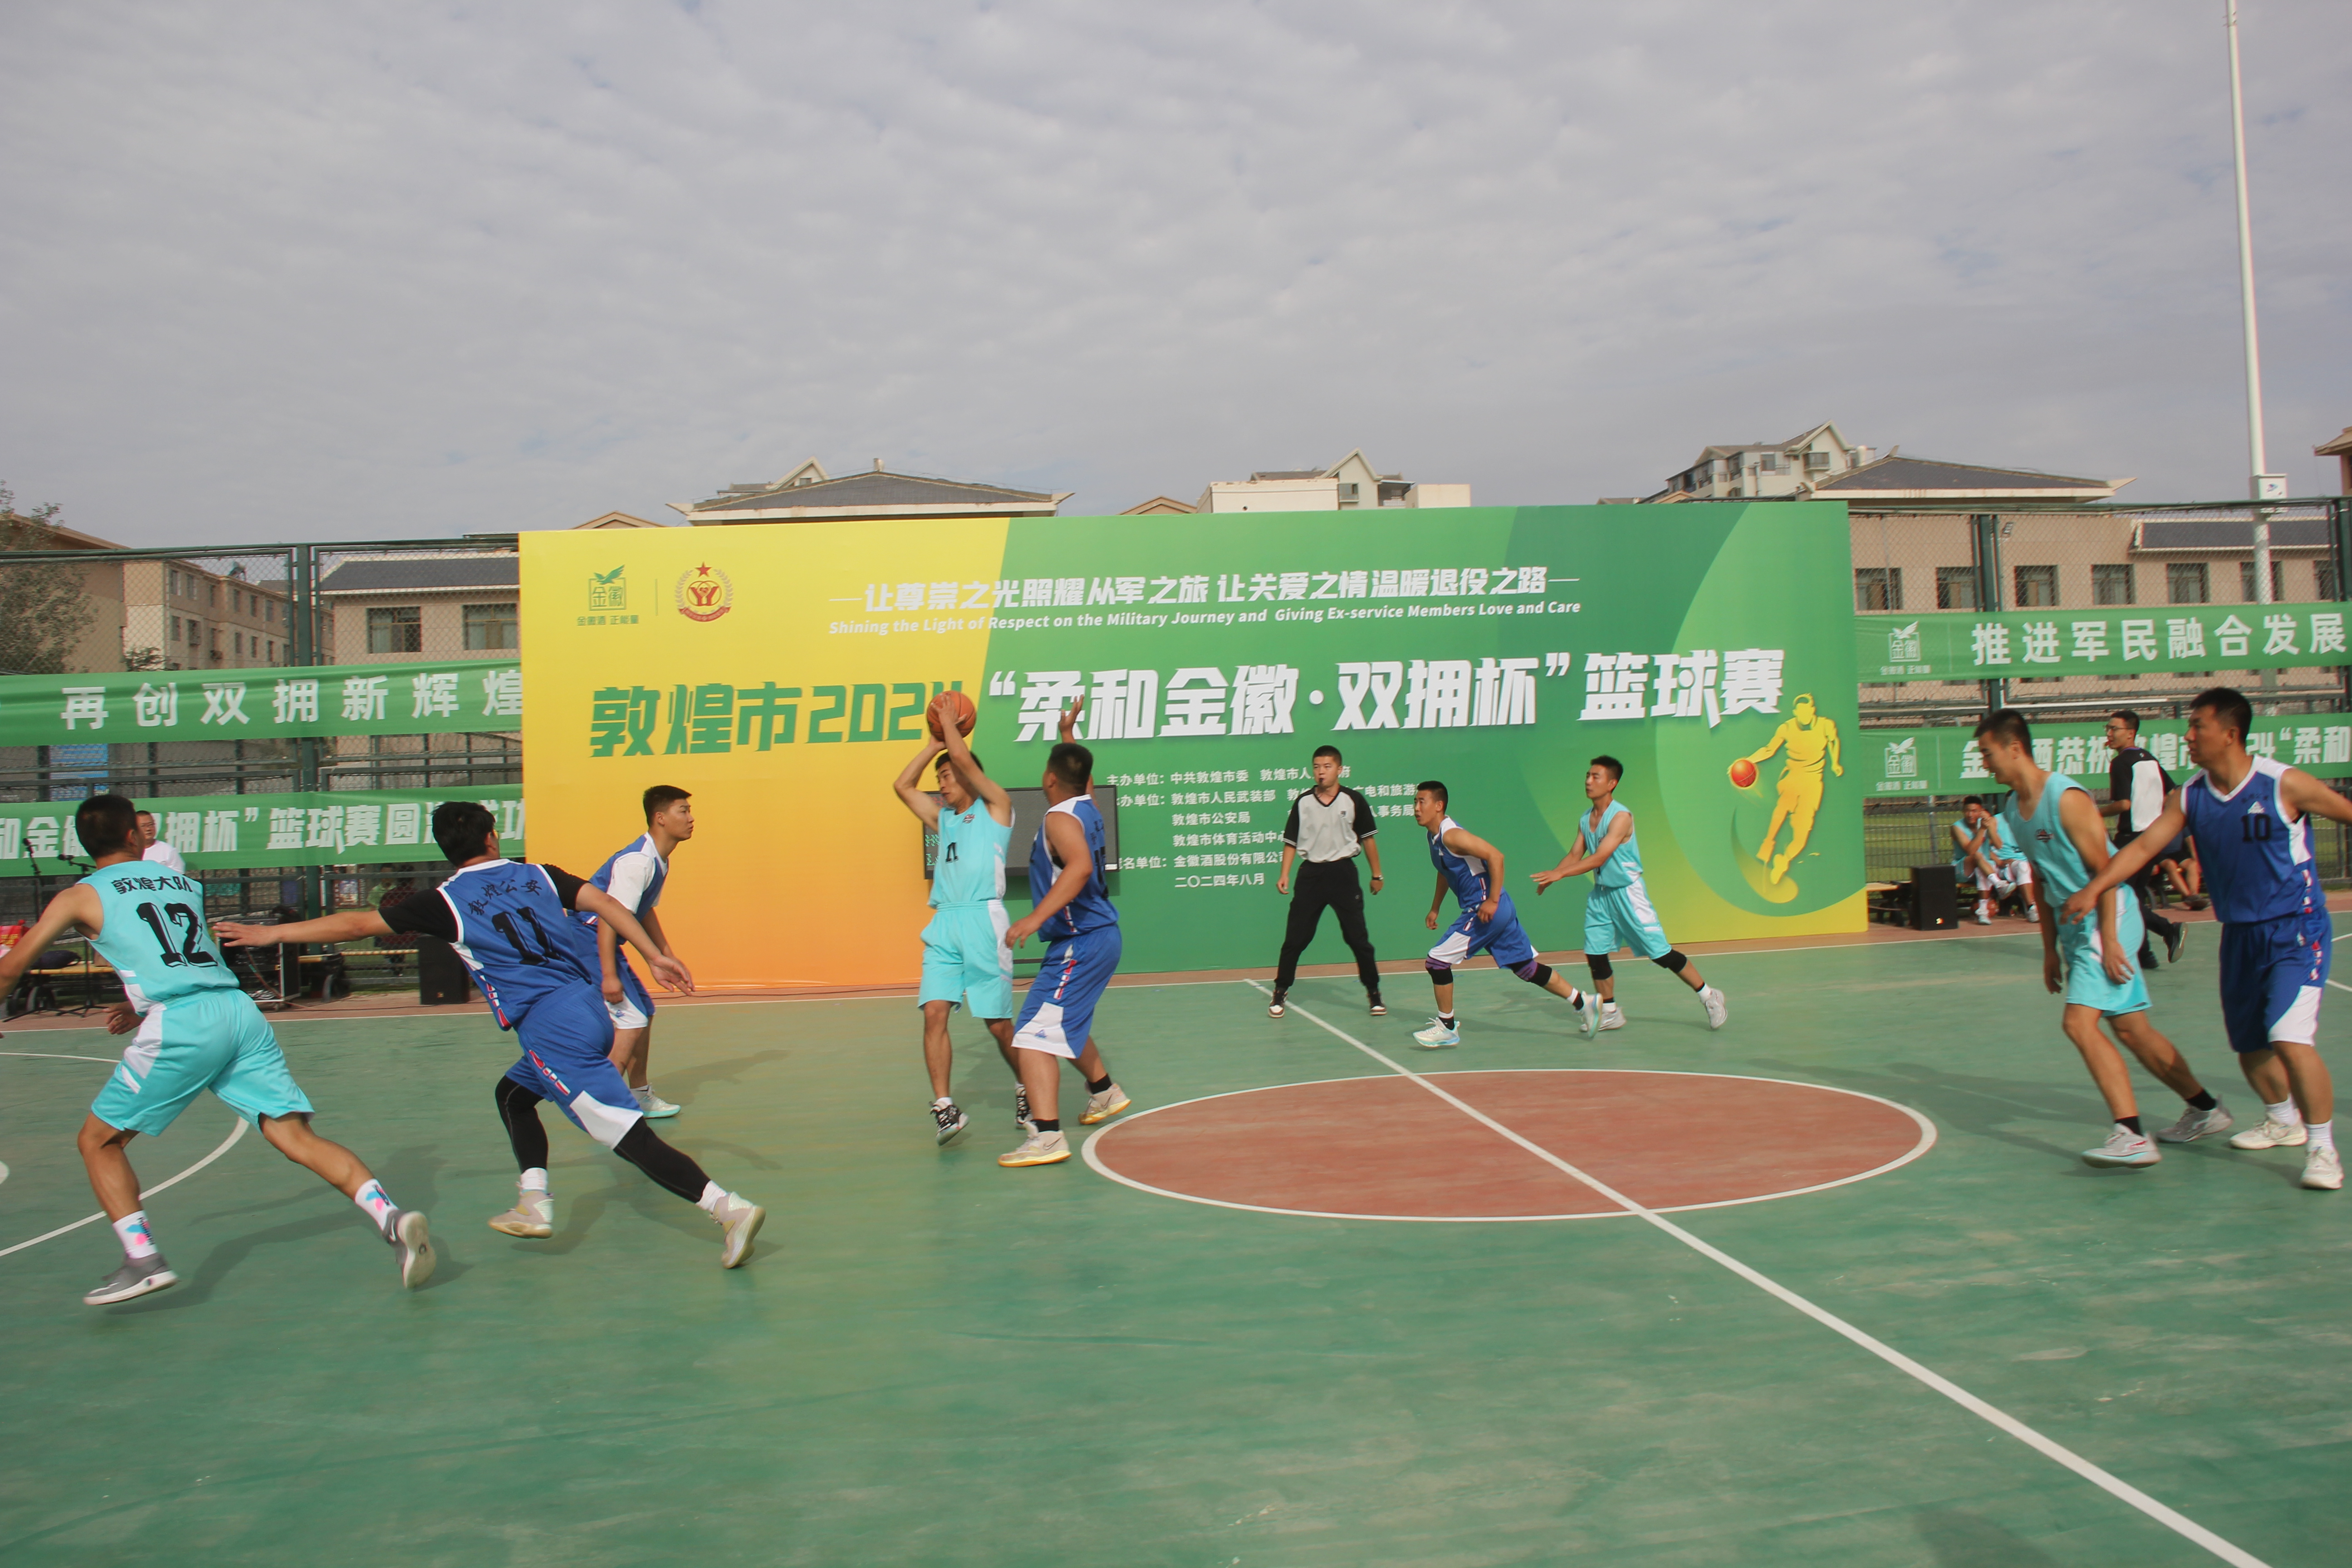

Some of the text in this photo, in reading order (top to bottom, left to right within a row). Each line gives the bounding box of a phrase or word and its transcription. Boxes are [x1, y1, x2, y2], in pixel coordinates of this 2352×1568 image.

[829, 601, 1581, 635] Shining the Light of Respect on the Military Journey and Giving Ex-service Members Love and Care
[1970, 613, 2347, 666] 推进军民融合发展
[60, 670, 523, 730] 再创双拥新辉煌
[589, 681, 963, 757] 敦煌市202
[1172, 811, 1250, 826] 敦煌市公安局
[2241, 814, 2271, 843] 10
[136, 902, 218, 968] 12
[491, 906, 566, 966] 11
